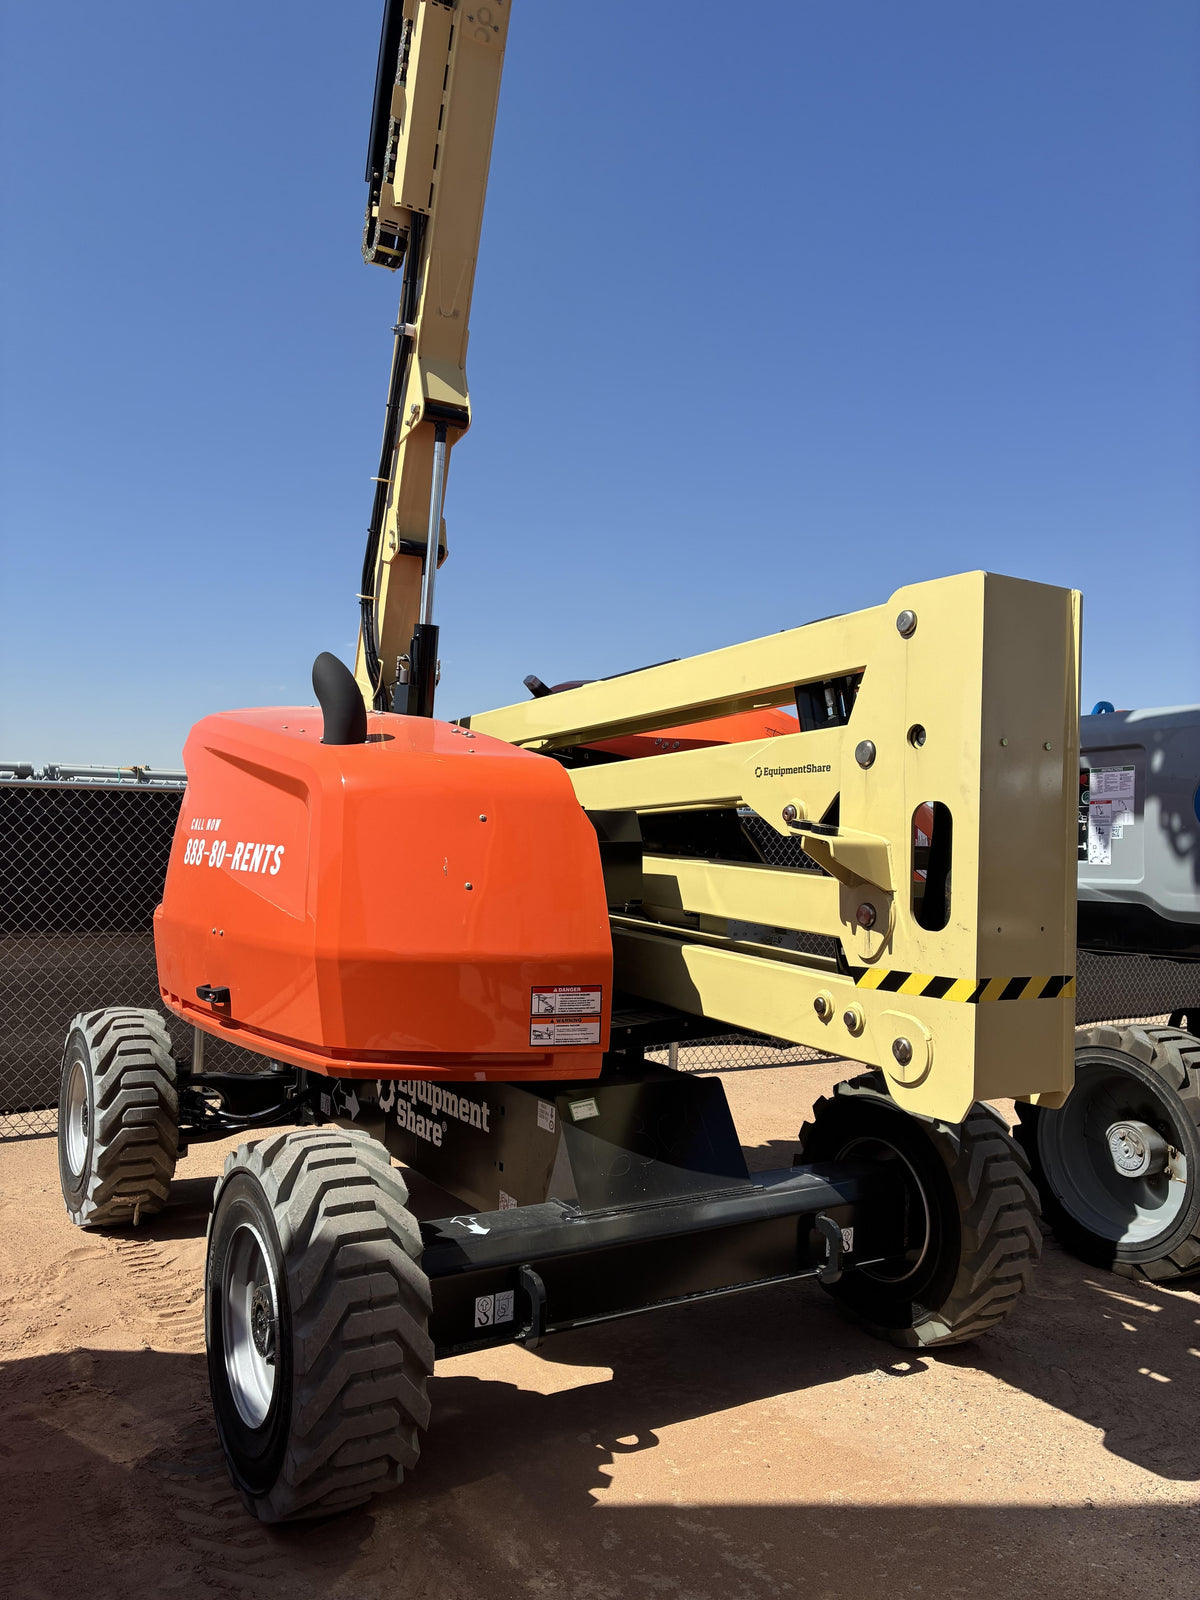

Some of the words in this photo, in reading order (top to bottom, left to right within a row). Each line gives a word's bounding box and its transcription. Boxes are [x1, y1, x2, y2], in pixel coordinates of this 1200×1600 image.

[764, 763, 831, 777] EquipmentShare
[191, 818, 204, 831] CALL
[206, 818, 222, 831] NOW
[183, 838, 285, 875] 888-80-RENTS
